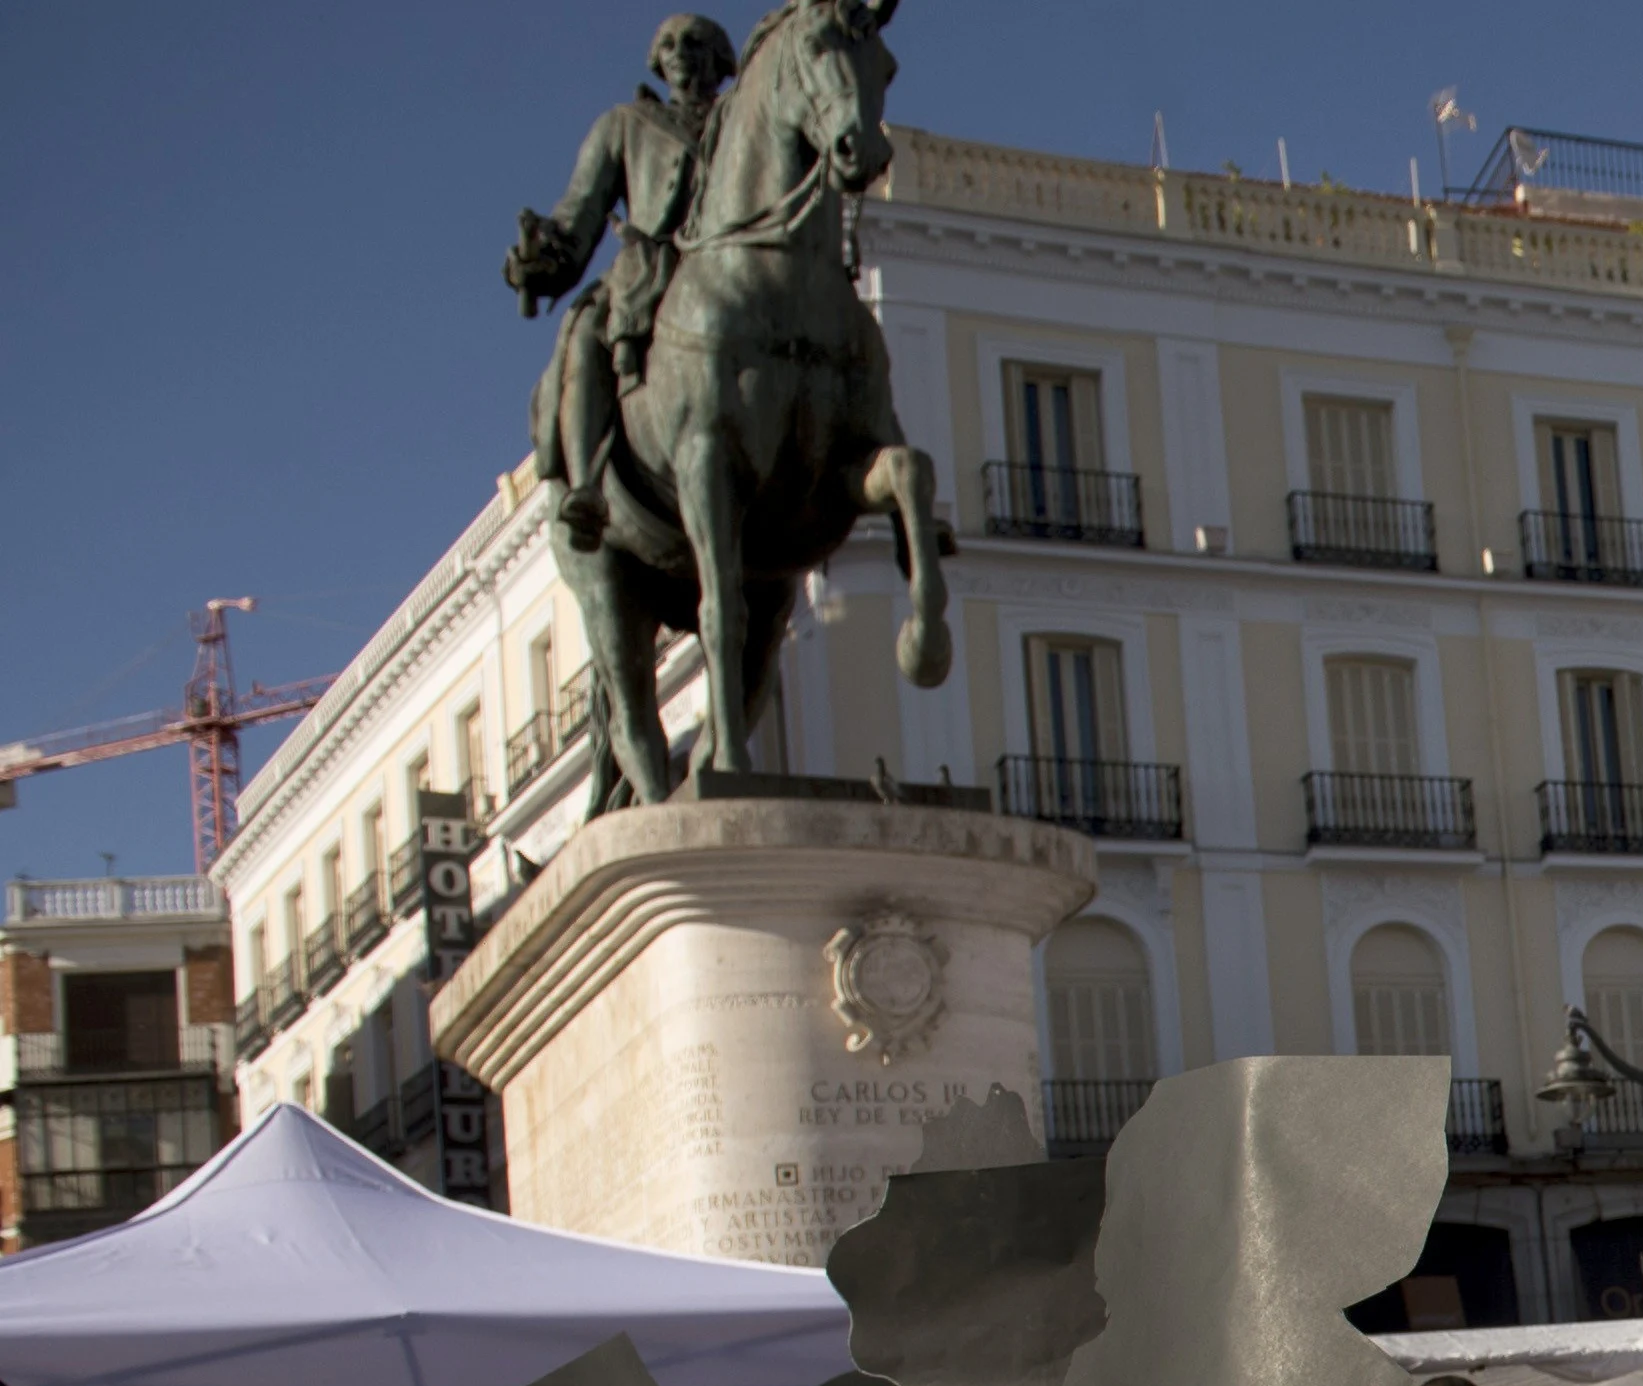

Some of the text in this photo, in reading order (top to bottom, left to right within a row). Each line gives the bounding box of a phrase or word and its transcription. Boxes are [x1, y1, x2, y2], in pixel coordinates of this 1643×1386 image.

[811, 1080, 927, 1104] CARLOS
[801, 1105, 842, 1126] REY
[857, 1106, 884, 1125] DE
[812, 1166, 866, 1183] HIJO
[727, 1206, 837, 1231] ARTISTAS
